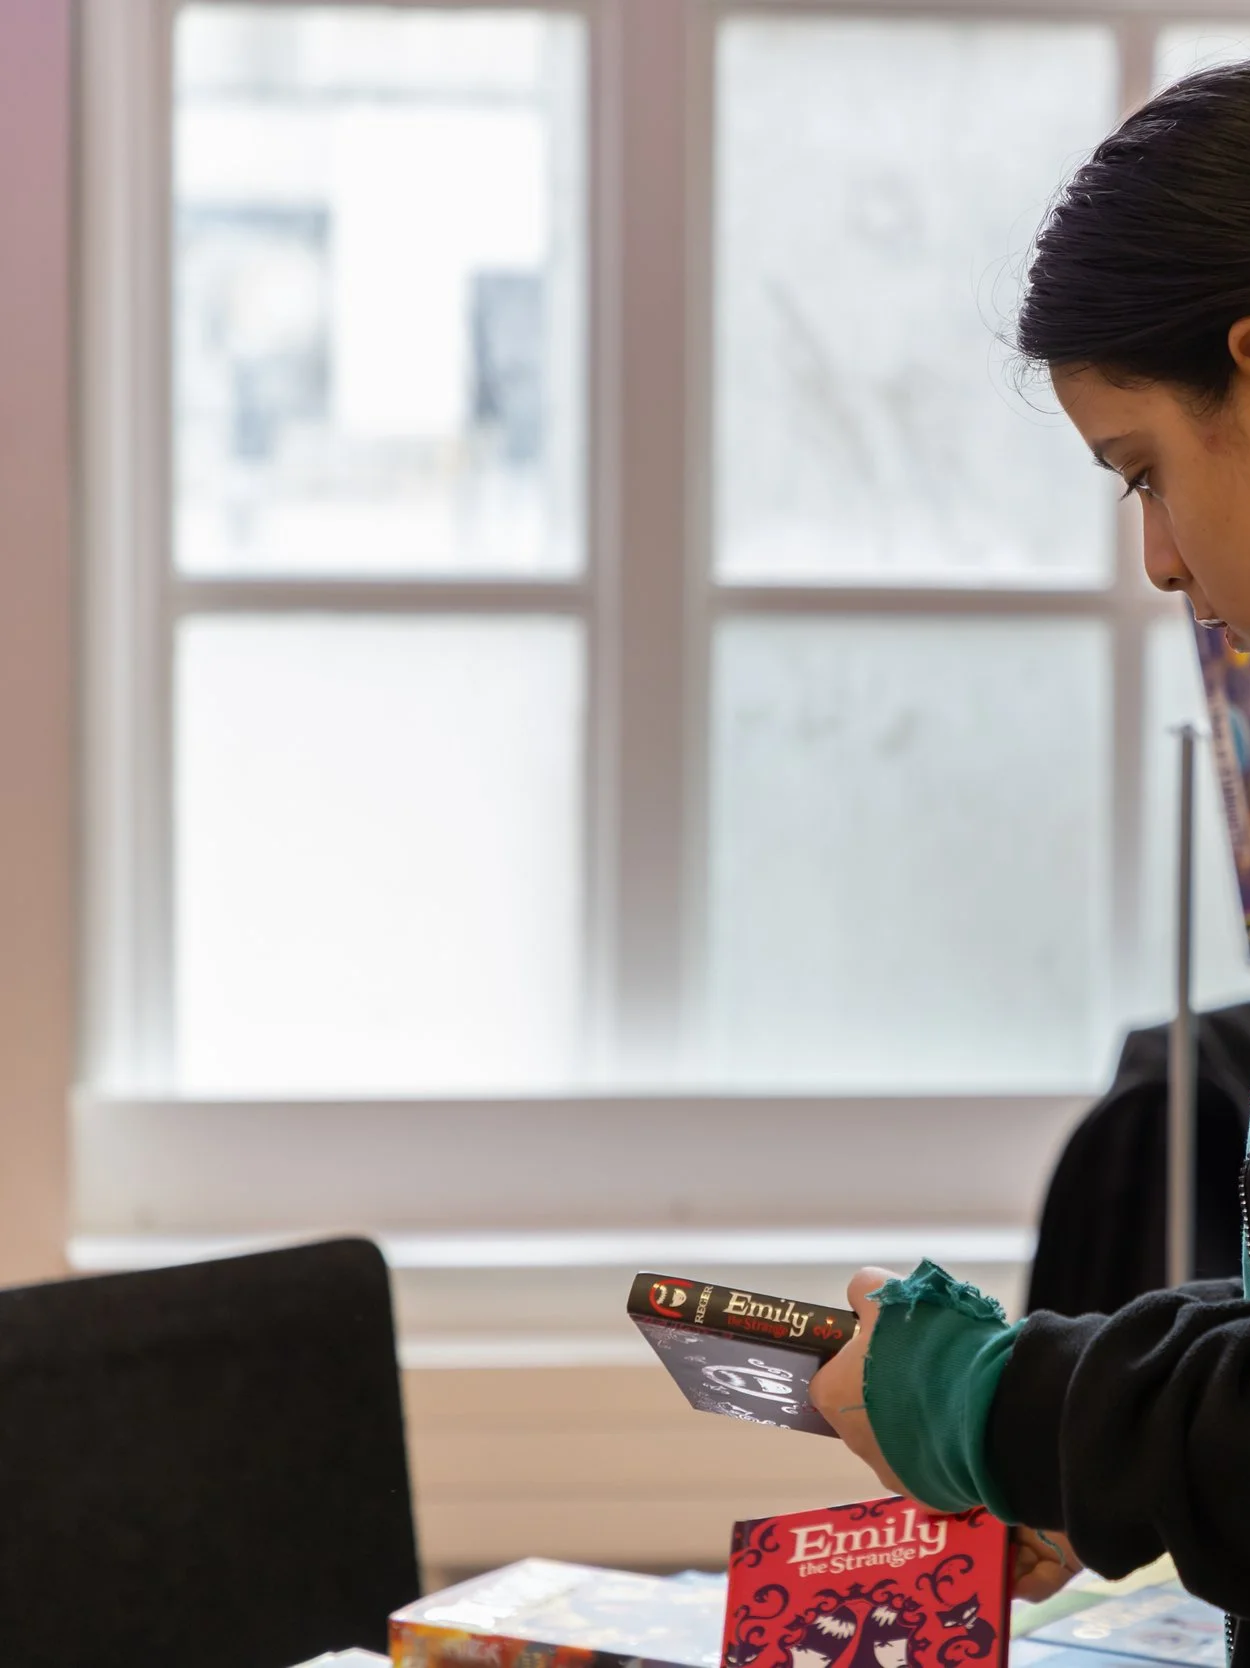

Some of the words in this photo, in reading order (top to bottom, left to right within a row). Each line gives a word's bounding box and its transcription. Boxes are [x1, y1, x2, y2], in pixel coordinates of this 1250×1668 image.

[694, 1285, 713, 1324] REGER
[723, 1291, 809, 1337] Emily
[744, 1316, 789, 1337] Strange
[786, 1508, 948, 1564] Emily
[798, 1561, 829, 1578] the
[829, 1546, 916, 1574] Strange
